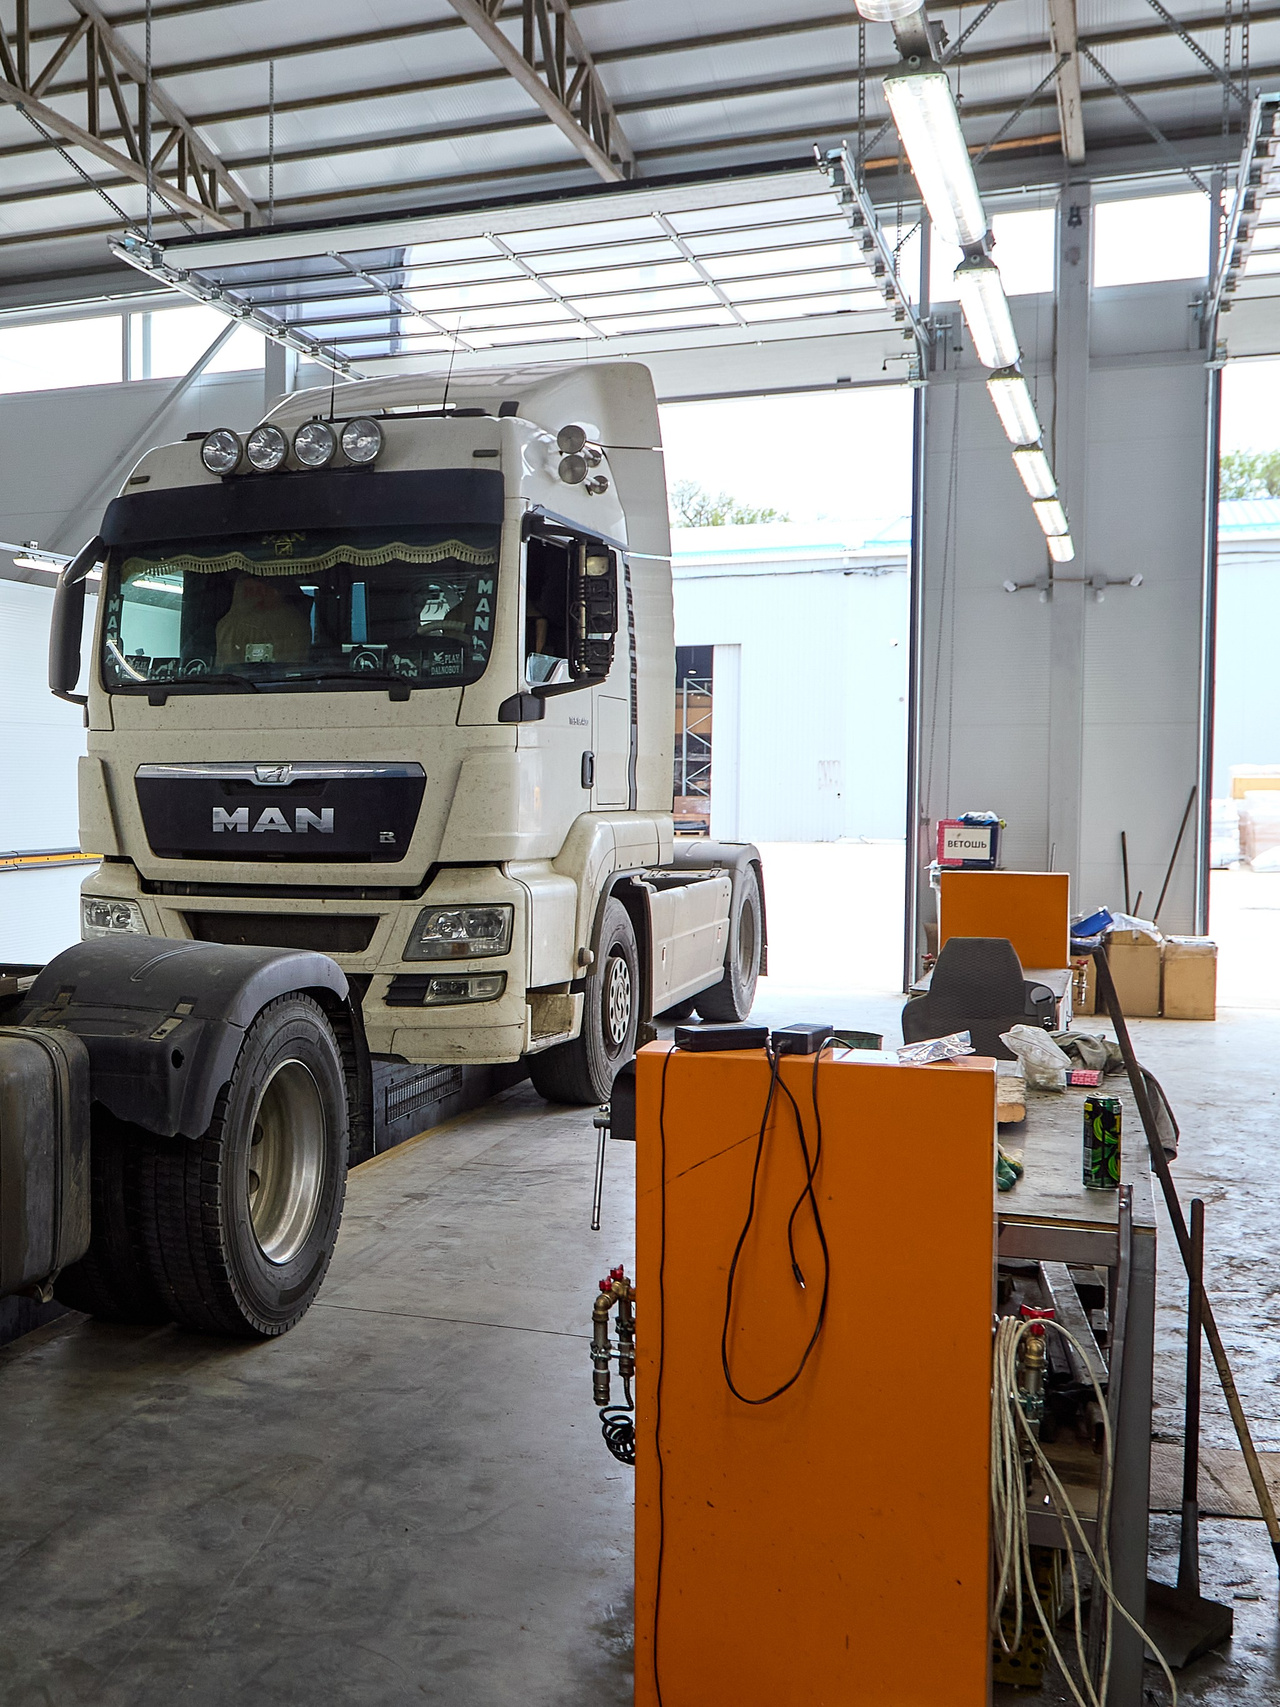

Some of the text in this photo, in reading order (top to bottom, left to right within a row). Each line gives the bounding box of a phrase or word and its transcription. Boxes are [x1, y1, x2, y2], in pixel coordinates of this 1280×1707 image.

[474, 579, 493, 631] MAN
[444, 654, 460, 664] PLAY
[212, 807, 335, 833] MAN
[947, 840, 987, 848] ВЕТОШЬ
